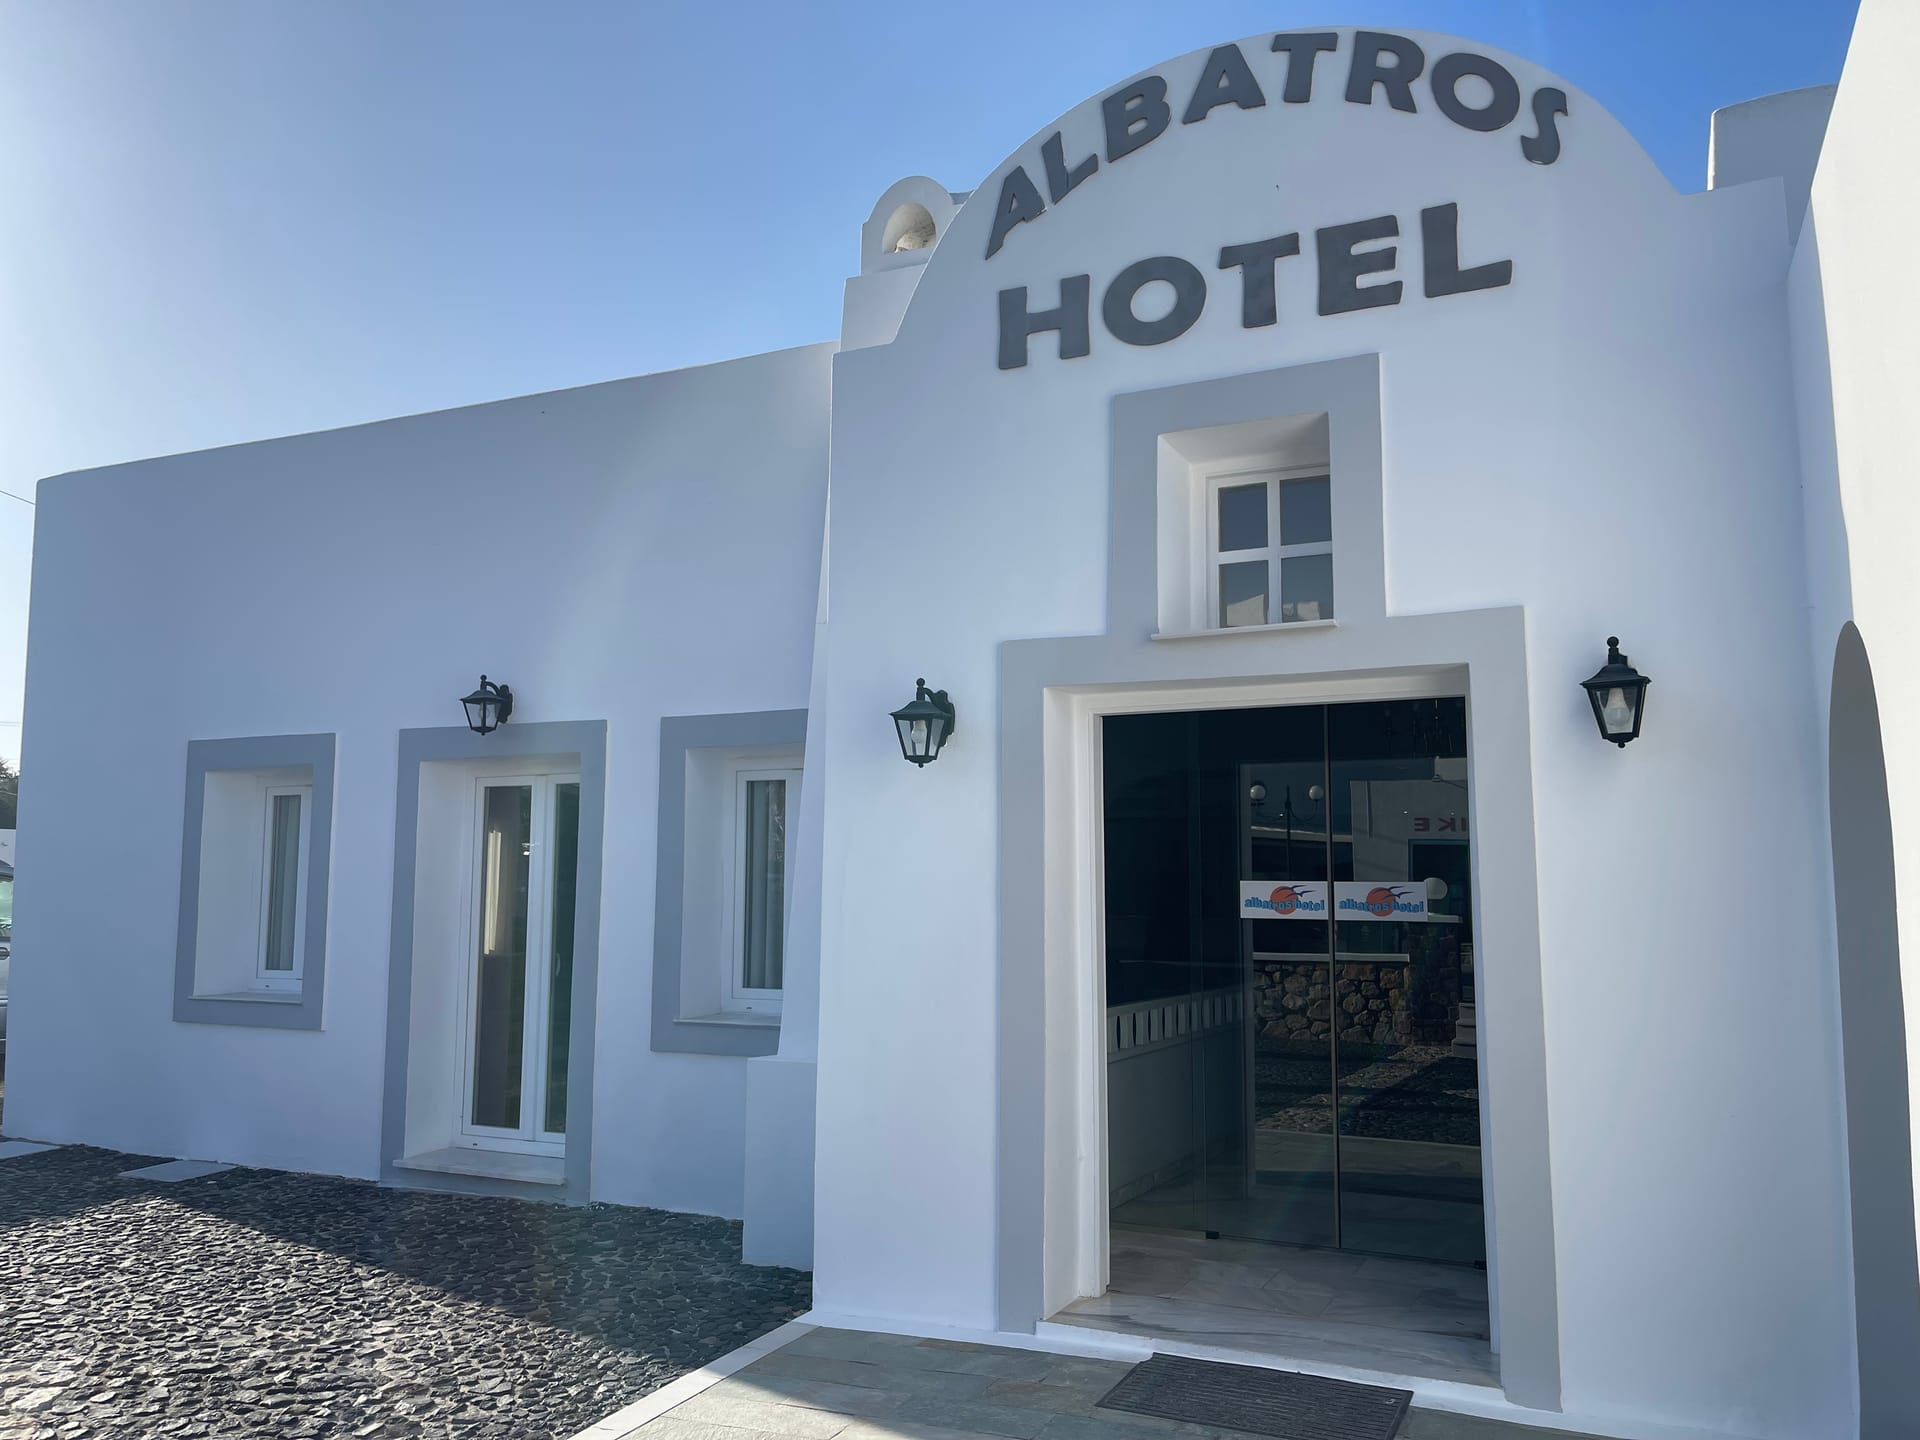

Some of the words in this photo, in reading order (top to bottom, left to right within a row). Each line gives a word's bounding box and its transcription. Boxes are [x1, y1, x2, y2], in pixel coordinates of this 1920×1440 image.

[985, 30, 1568, 260] ALBATROS
[998, 202, 1513, 370] HOTEL
[1244, 896, 1292, 911] albatros
[1294, 898, 1325, 912] hotel
[1339, 897, 1389, 912] albatros
[1391, 899, 1424, 913] hotel
